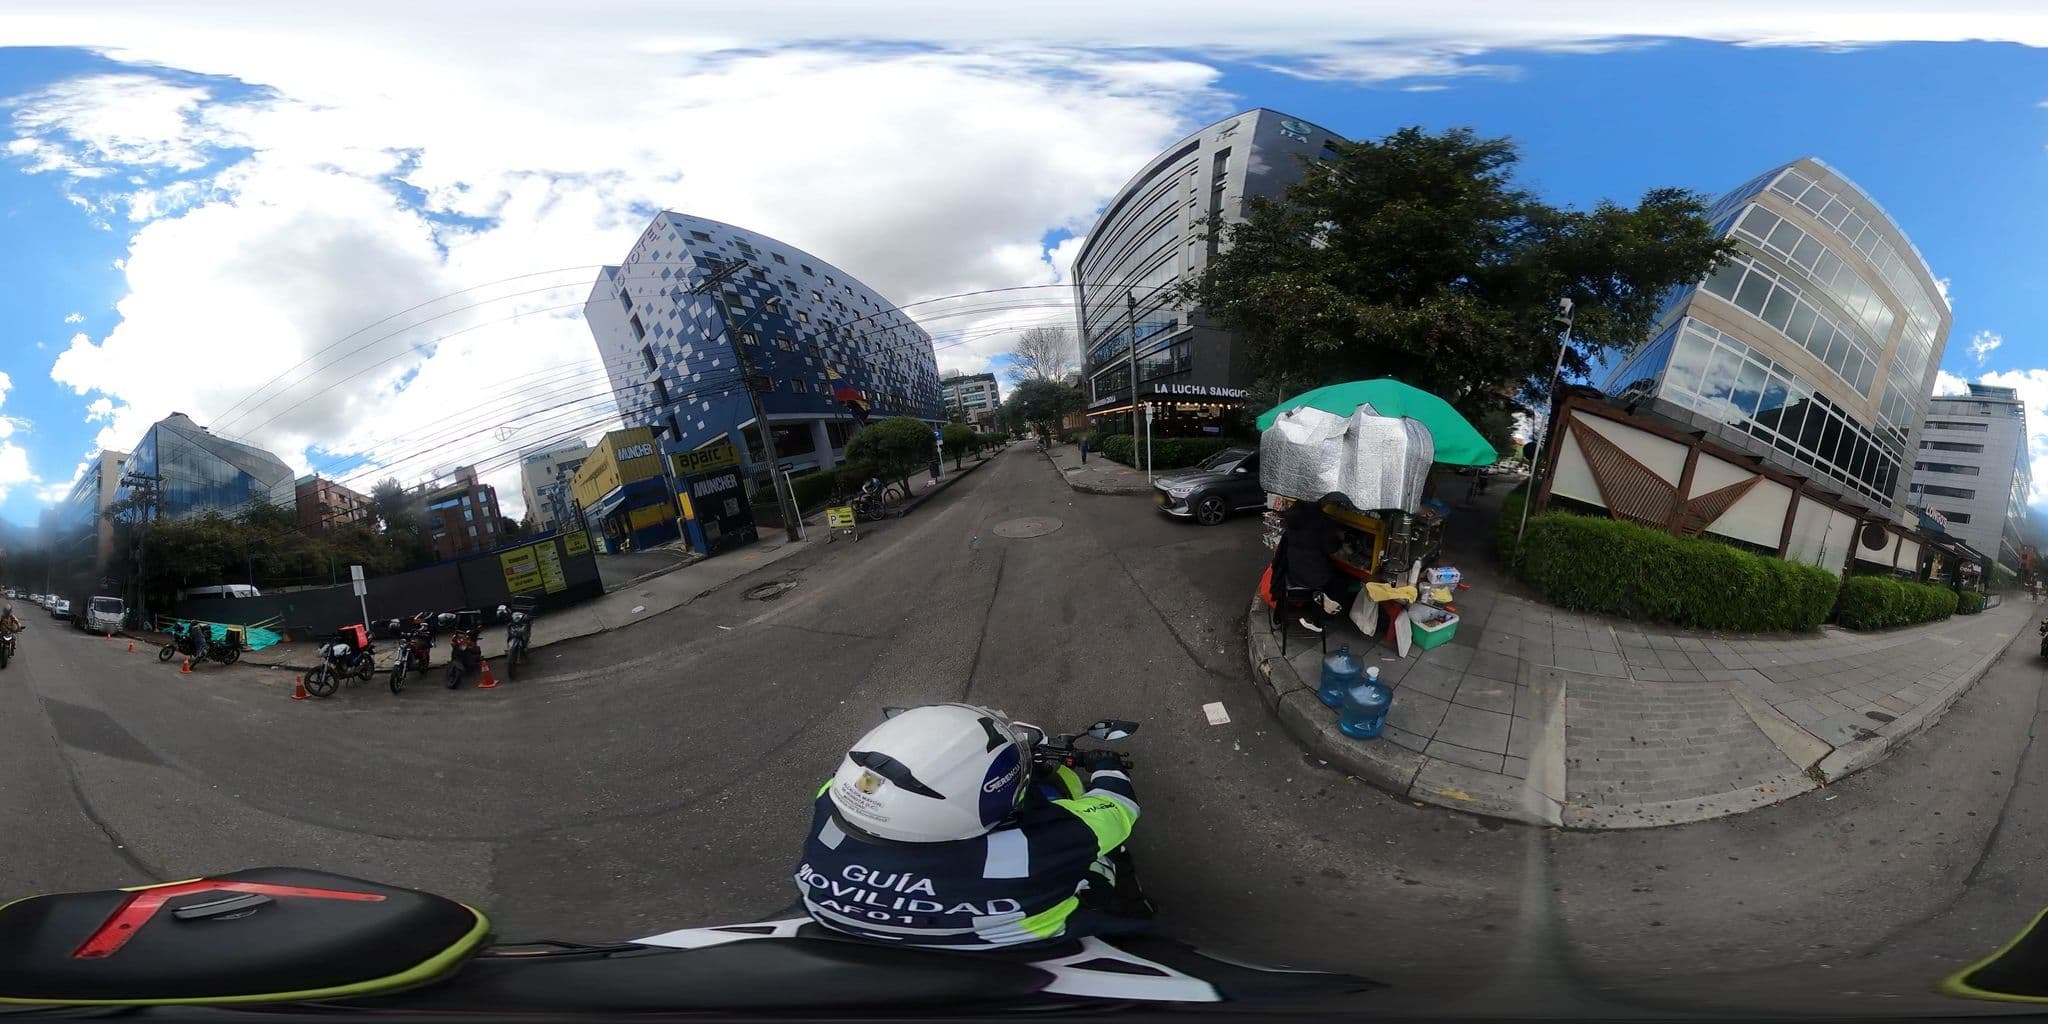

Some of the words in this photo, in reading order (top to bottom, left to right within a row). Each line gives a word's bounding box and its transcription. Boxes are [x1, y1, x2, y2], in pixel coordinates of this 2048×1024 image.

[1154, 384, 1168, 394] LA
[1172, 384, 1207, 396] LUCHA
[617, 443, 653, 461] MUNCHER
[693, 474, 738, 497] MUNCHER
[799, 863, 1022, 915] MOVILIDAD
[842, 864, 936, 896] GUÍA
